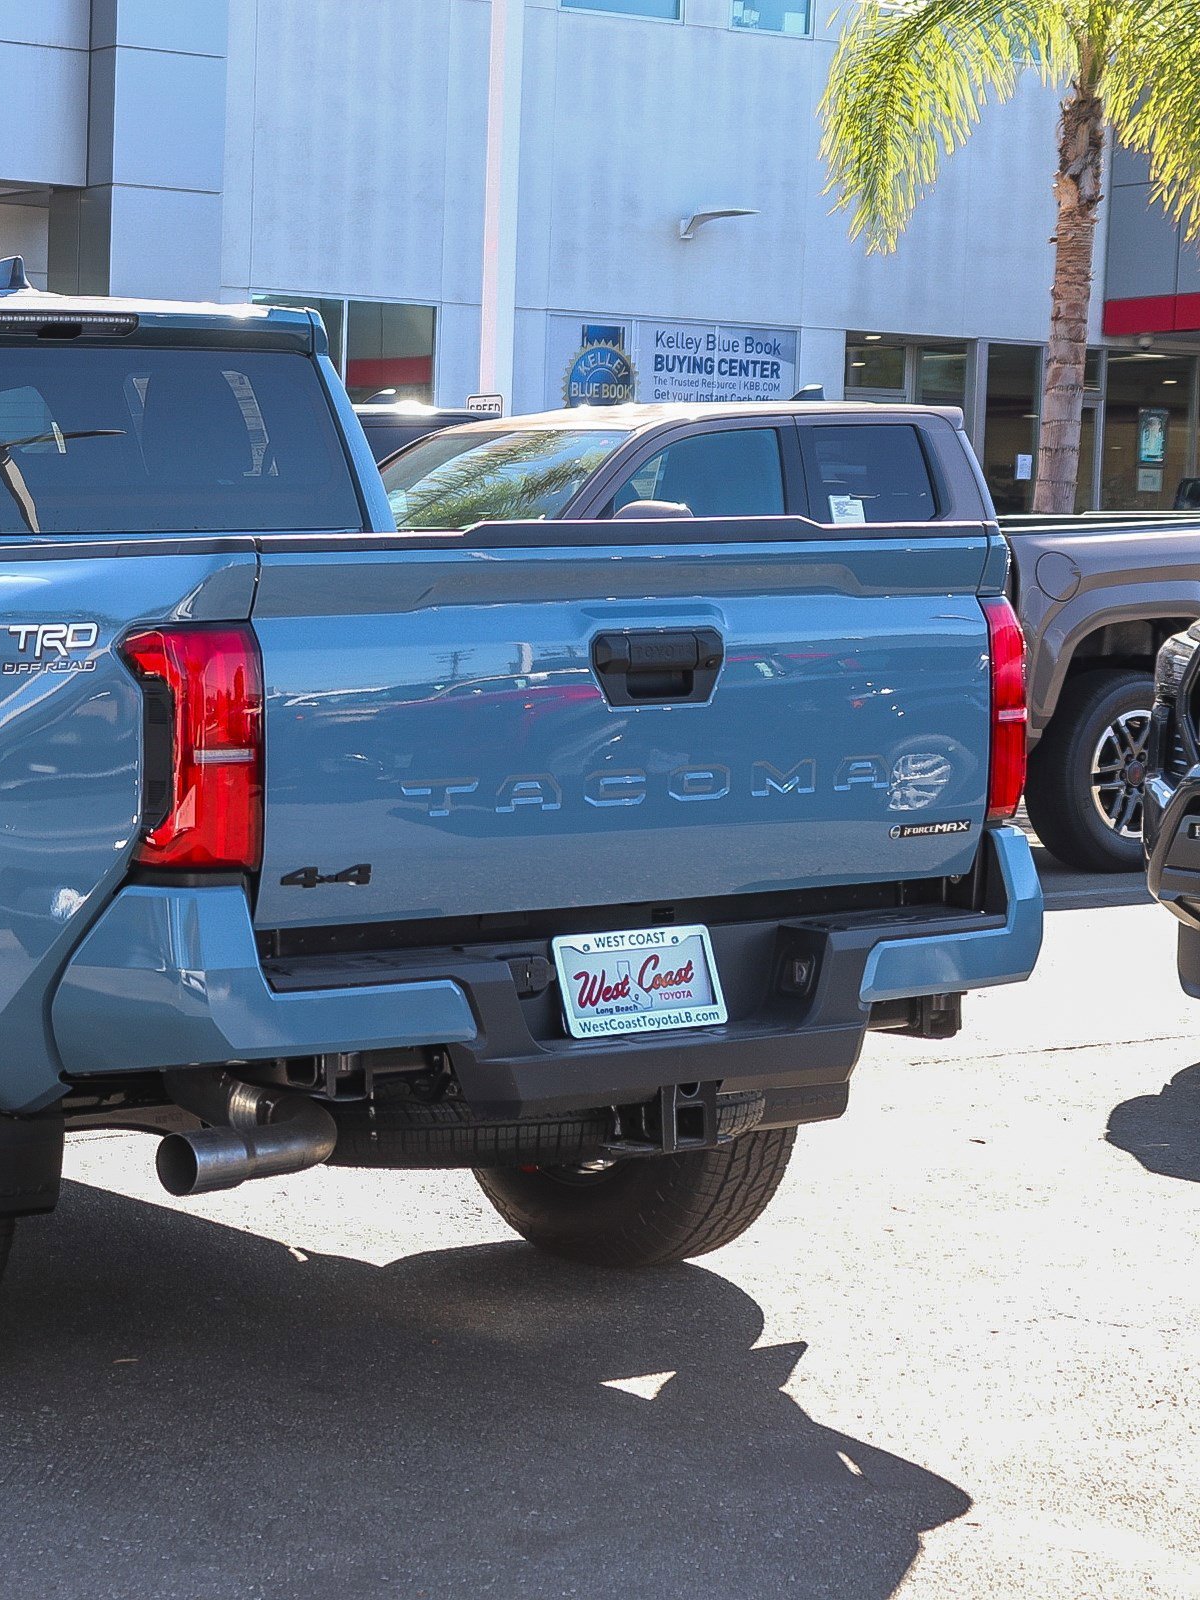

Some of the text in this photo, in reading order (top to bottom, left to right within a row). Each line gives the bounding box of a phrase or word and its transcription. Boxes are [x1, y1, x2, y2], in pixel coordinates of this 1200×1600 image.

[655, 330, 782, 356] Kelley Blue Book
[578, 351, 629, 378] KELLEY
[654, 353, 781, 379] BUYING CENTER
[571, 381, 633, 399] BLUE BOOK
[653, 375, 668, 386] The
[670, 376, 699, 388] Trusted
[654, 388, 670, 400] Get
[672, 391, 694, 402] your
[8, 621, 100, 660] TRD
[2, 659, 97, 676] OFF ROAD
[400, 754, 891, 817] TACOMA
[593, 931, 666, 949] WEST COAST
[572, 953, 695, 1009] West Coast
[658, 990, 693, 1001] TOYOTA
[595, 1004, 639, 1015] Long Beach
[578, 1010, 720, 1034] WestCoastToyotaLB.com
